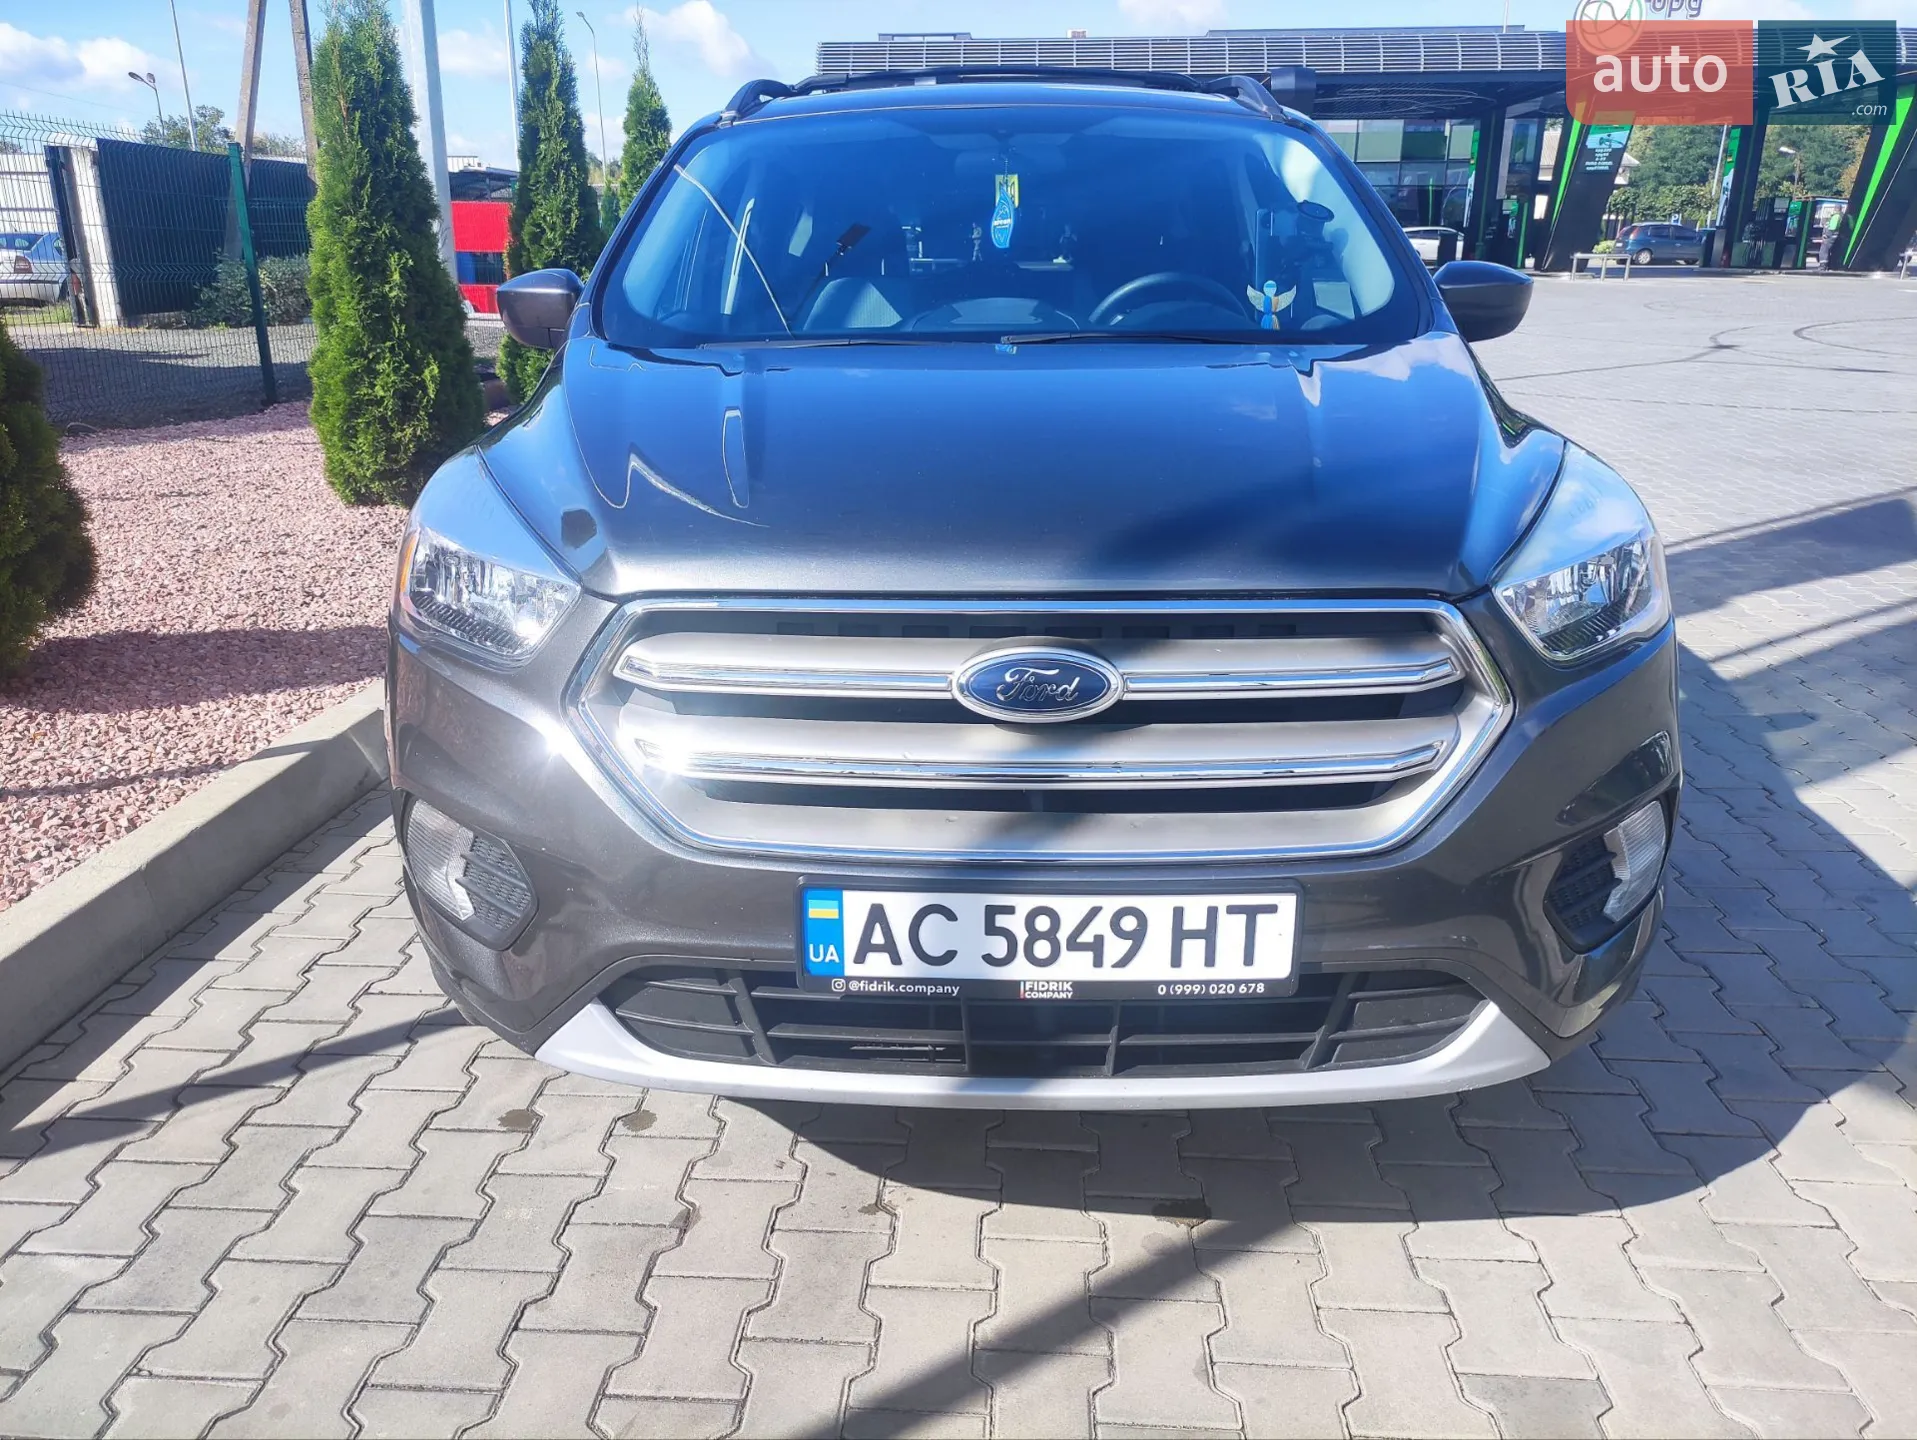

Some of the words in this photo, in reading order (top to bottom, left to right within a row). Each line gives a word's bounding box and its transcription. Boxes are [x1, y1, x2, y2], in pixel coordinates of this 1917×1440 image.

[996, 667, 1080, 701] Ford
[853, 903, 959, 967] AC
[981, 904, 1148, 969] 5849
[1170, 904, 1279, 968] HT
[809, 944, 840, 963] UA
[849, 979, 960, 996] @fidrik.company
[1025, 981, 1073, 991] FIDRIK
[1157, 984, 1167, 995] 0
[1169, 984, 1206, 995] (999)
[1209, 983, 1236, 994] 020
[1238, 982, 1265, 994] 678
[1025, 991, 1073, 999] COMPANY
